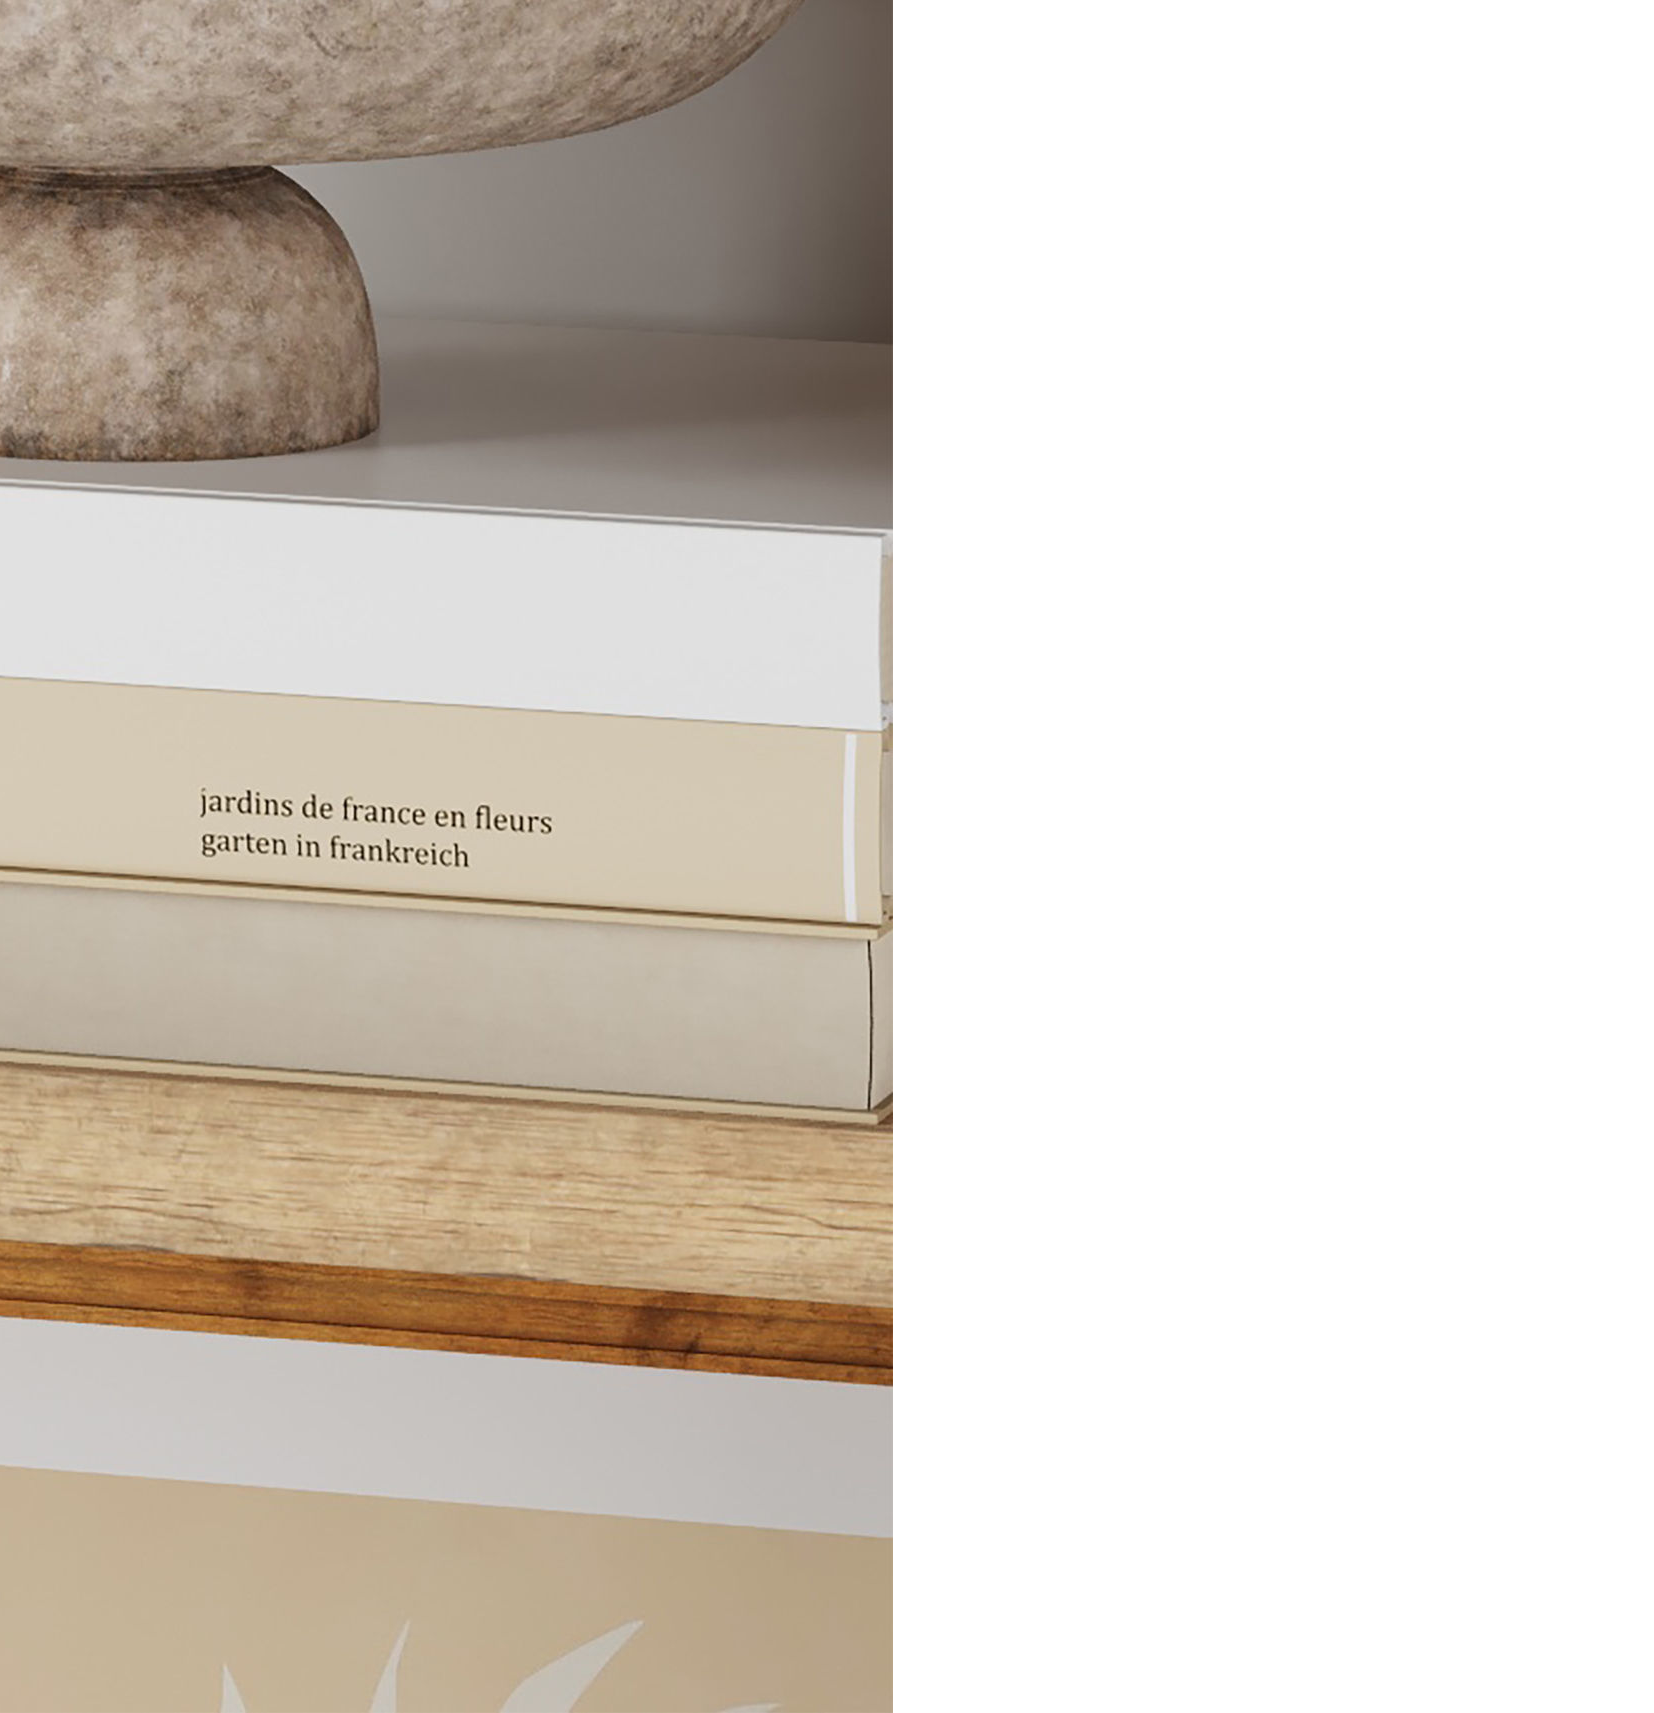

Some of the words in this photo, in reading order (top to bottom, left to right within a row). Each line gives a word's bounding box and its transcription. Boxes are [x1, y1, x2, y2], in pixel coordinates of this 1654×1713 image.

[200, 787, 294, 818] jardins
[301, 793, 334, 820] de
[342, 795, 426, 826] france
[434, 809, 467, 829] en
[475, 804, 553, 835] fleurs
[201, 832, 288, 858] garten
[296, 833, 321, 858] in
[330, 834, 470, 868] frankreich
